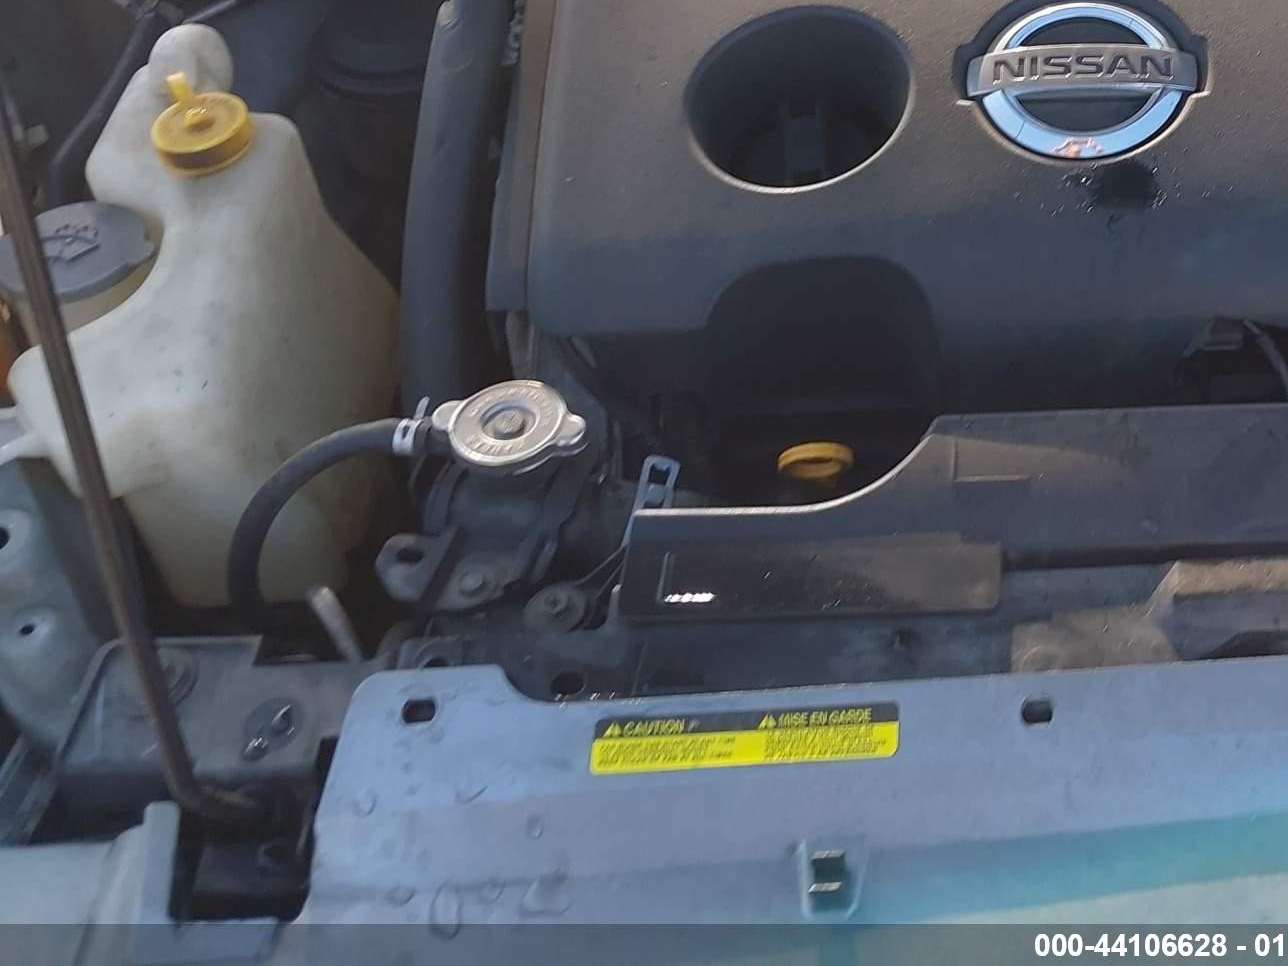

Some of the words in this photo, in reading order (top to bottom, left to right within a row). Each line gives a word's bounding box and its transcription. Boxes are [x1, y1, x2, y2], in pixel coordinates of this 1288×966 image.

[992, 54, 1174, 84] NISSAN
[623, 719, 685, 736] CAUTION
[777, 712, 809, 728] MISE
[810, 711, 829, 726] EN
[829, 708, 872, 725] GARDE
